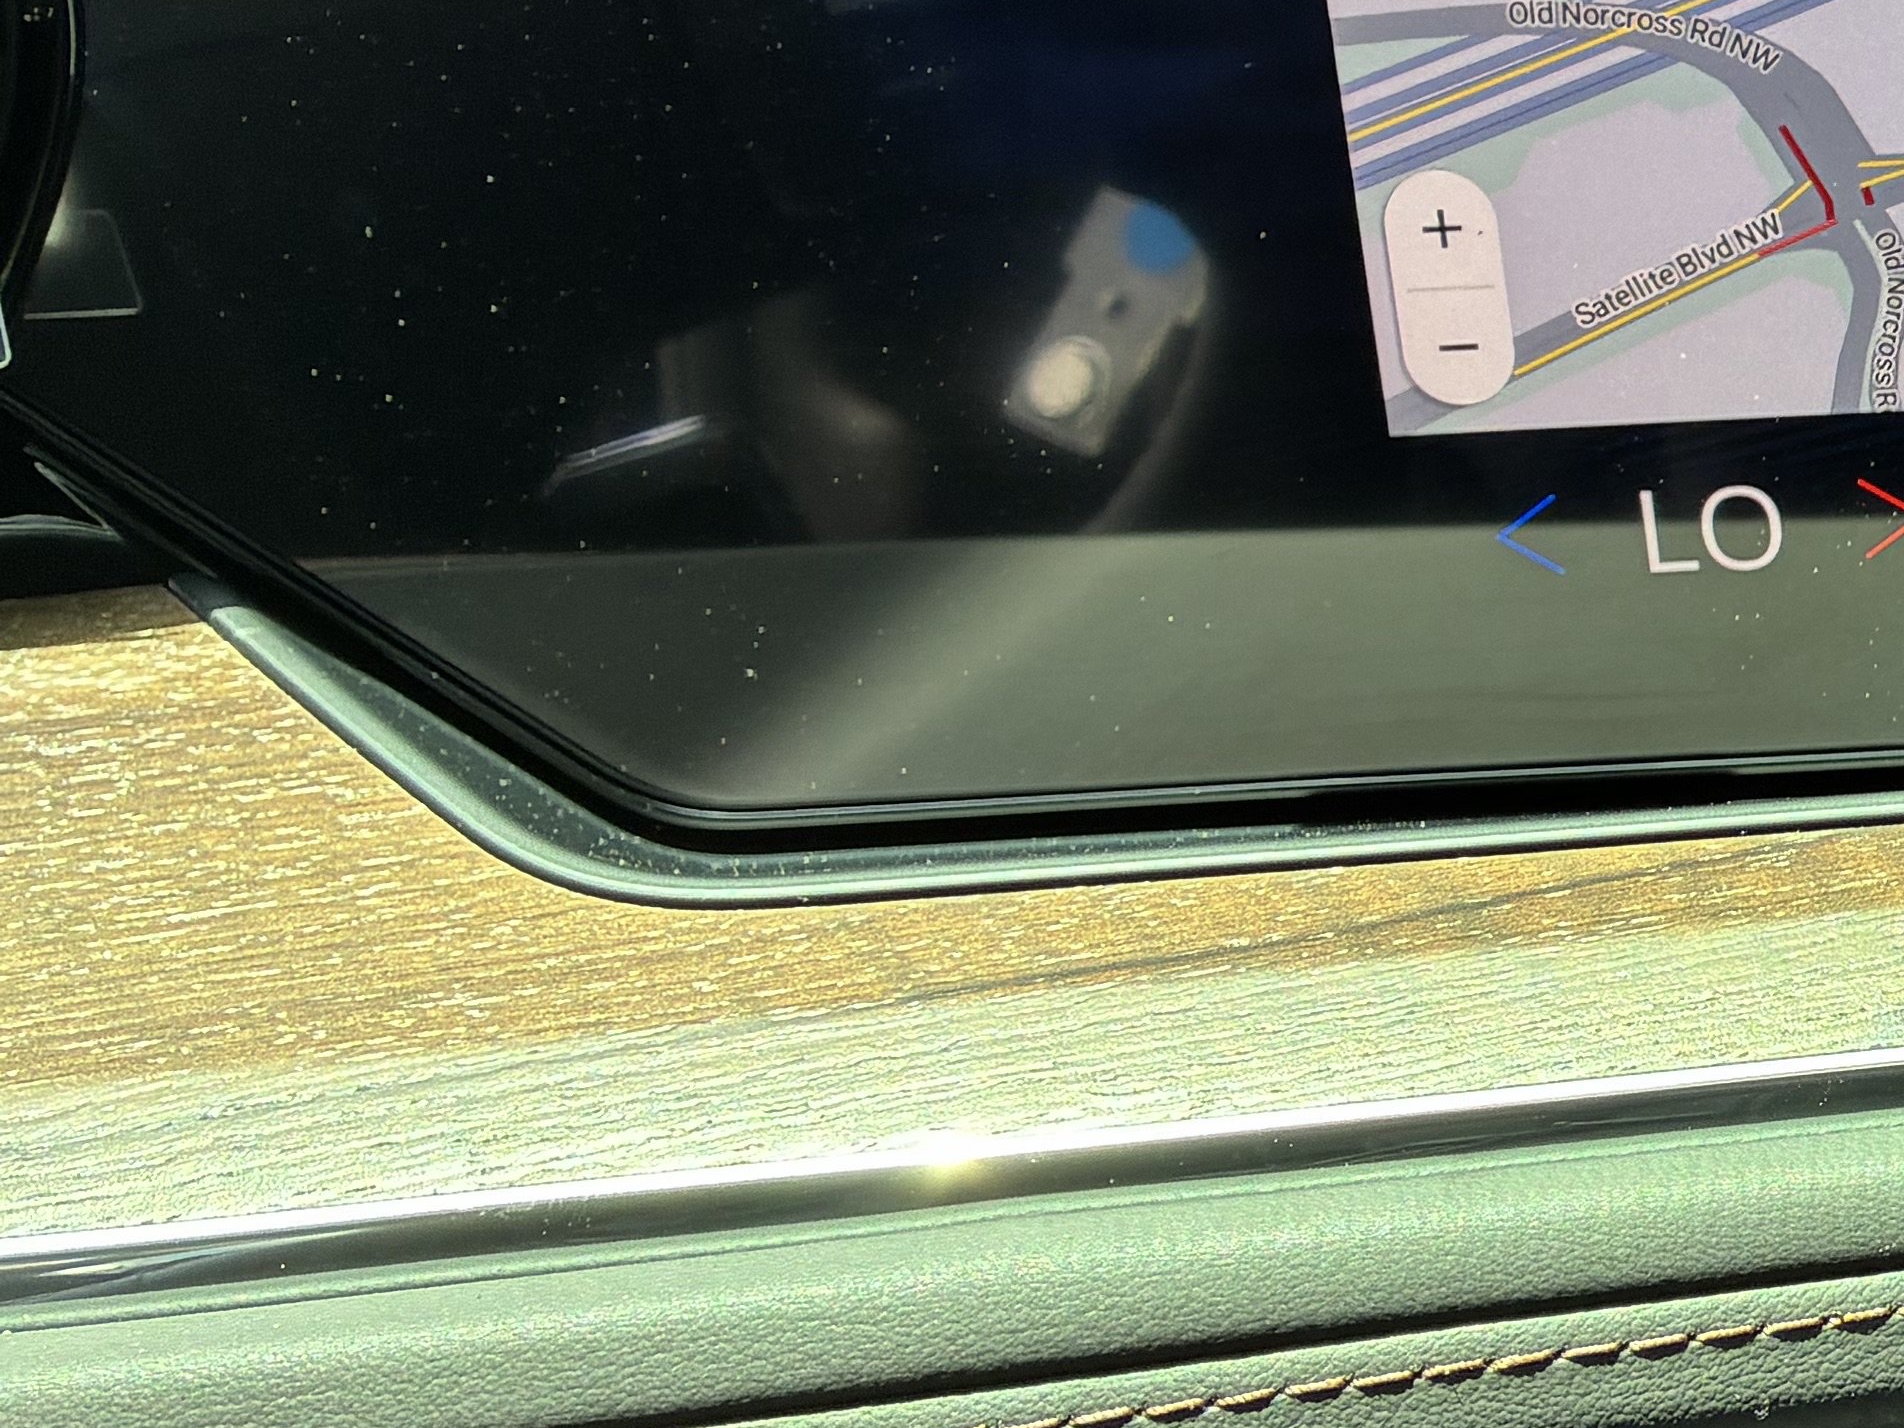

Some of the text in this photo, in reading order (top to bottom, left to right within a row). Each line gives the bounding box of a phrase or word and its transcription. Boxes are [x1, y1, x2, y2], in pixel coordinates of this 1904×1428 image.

[1507, 0, 1781, 74] Old Norcross Rd NW
[1574, 209, 1782, 327] Satellite Blvd NW
[1639, 484, 1785, 573] LO
